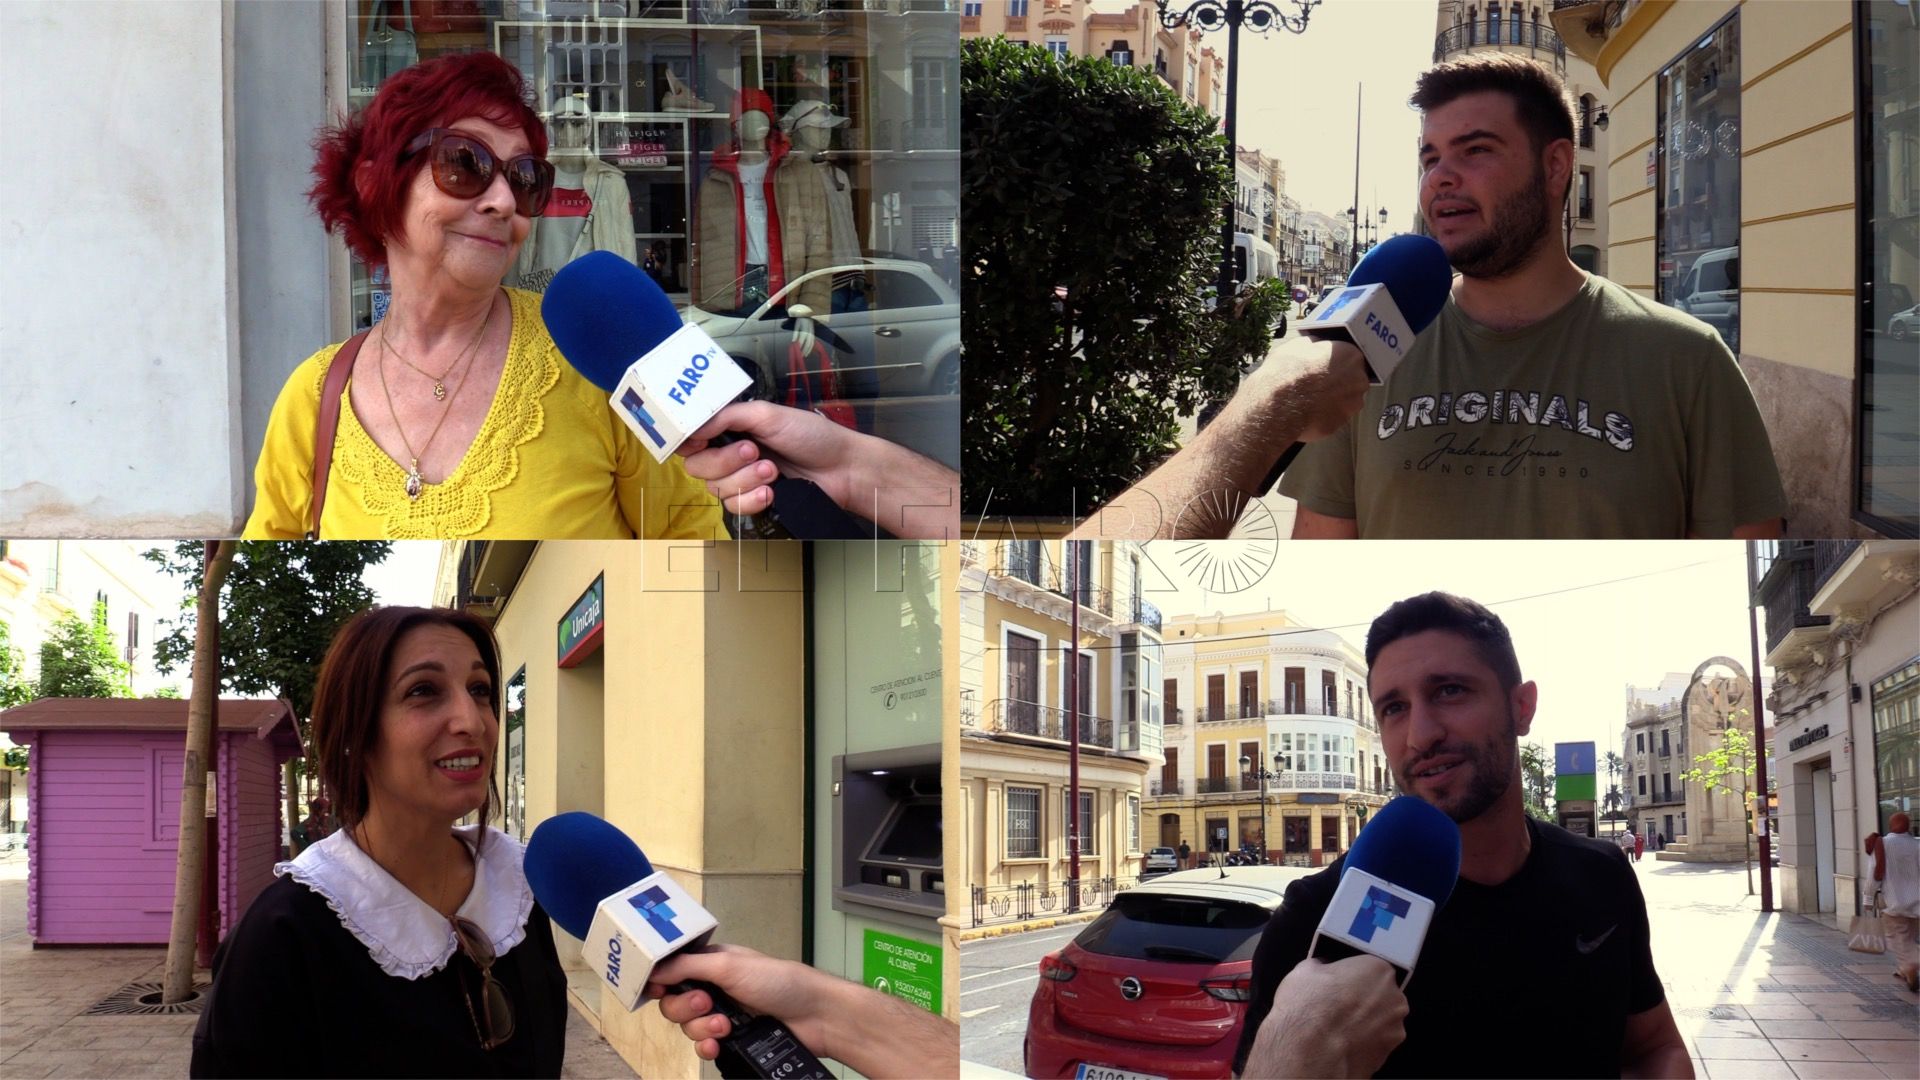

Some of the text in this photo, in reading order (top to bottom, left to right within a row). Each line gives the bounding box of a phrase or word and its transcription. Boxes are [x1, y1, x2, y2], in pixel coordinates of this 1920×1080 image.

[1365, 311, 1398, 348] FARO
[668, 347, 717, 405] FARO TV
[1377, 389, 1635, 452] ORIGINALS
[1404, 459, 1588, 478] SINCE 1990
[572, 593, 600, 638] Unicaja
[607, 938, 621, 988] FARO
[874, 940, 933, 965] CENTRO DE ATENCIÓN
[888, 956, 917, 973] AL CLIENTE
